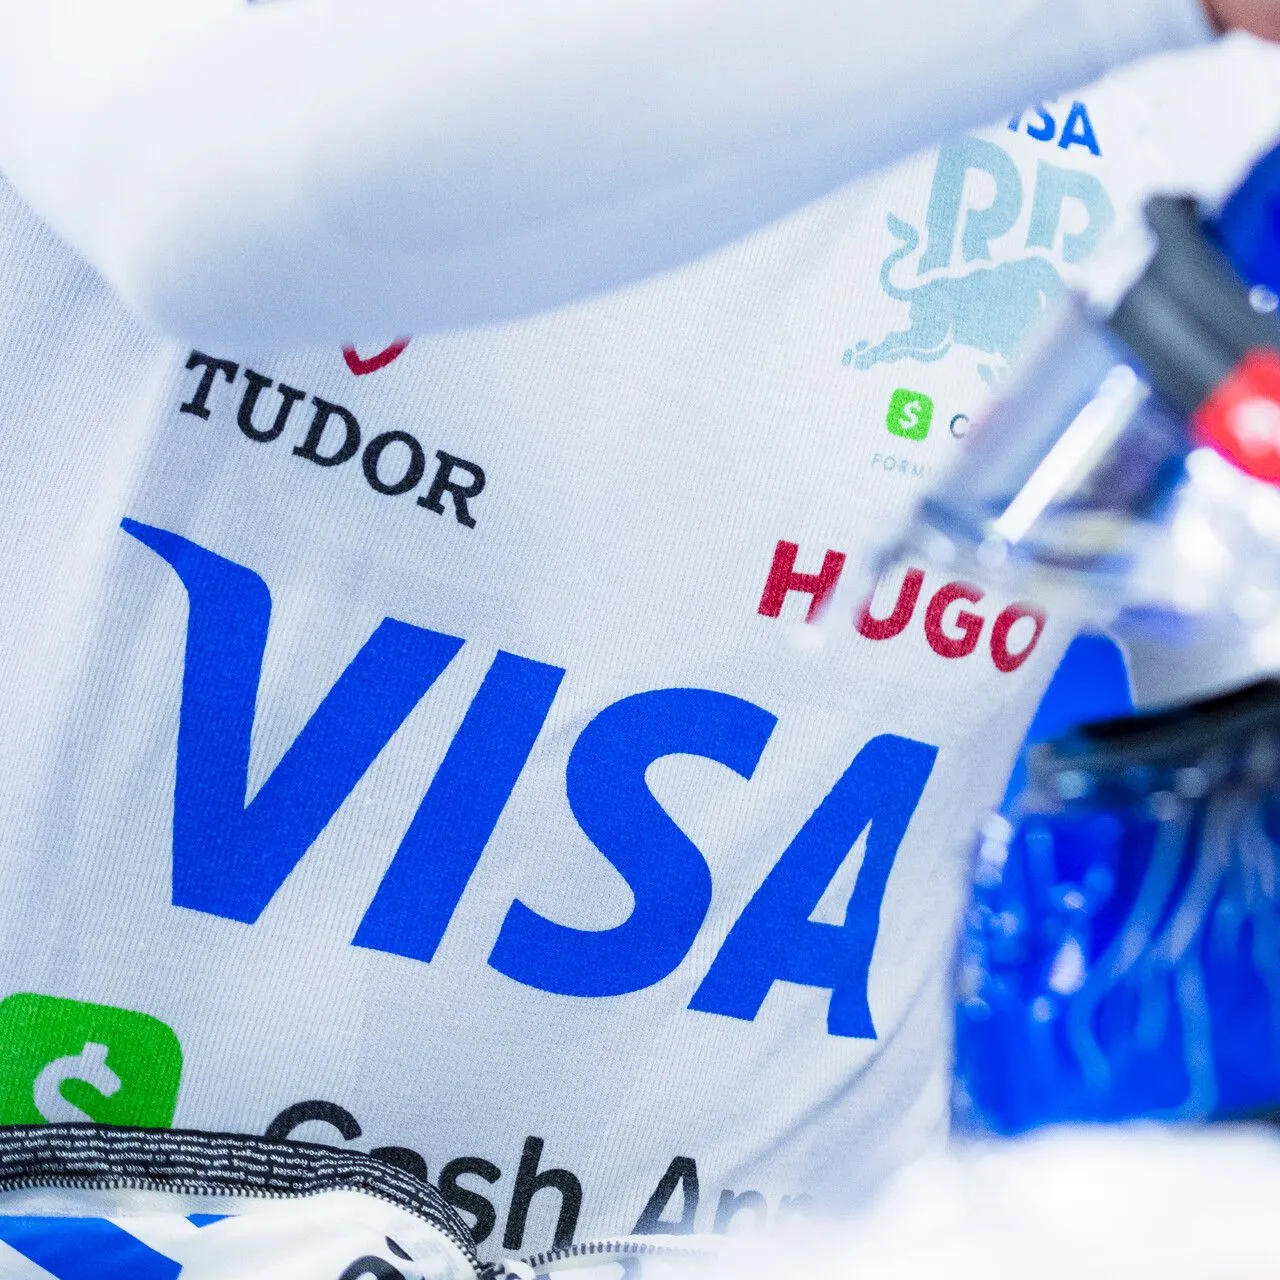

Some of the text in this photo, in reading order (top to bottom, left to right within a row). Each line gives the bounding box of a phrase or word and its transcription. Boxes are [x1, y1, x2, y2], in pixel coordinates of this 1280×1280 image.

[1006, 99, 1102, 157] SA
[179, 349, 487, 530] TUDOR
[757, 539, 1048, 674] HUGO
[119, 516, 939, 1040] VISA
